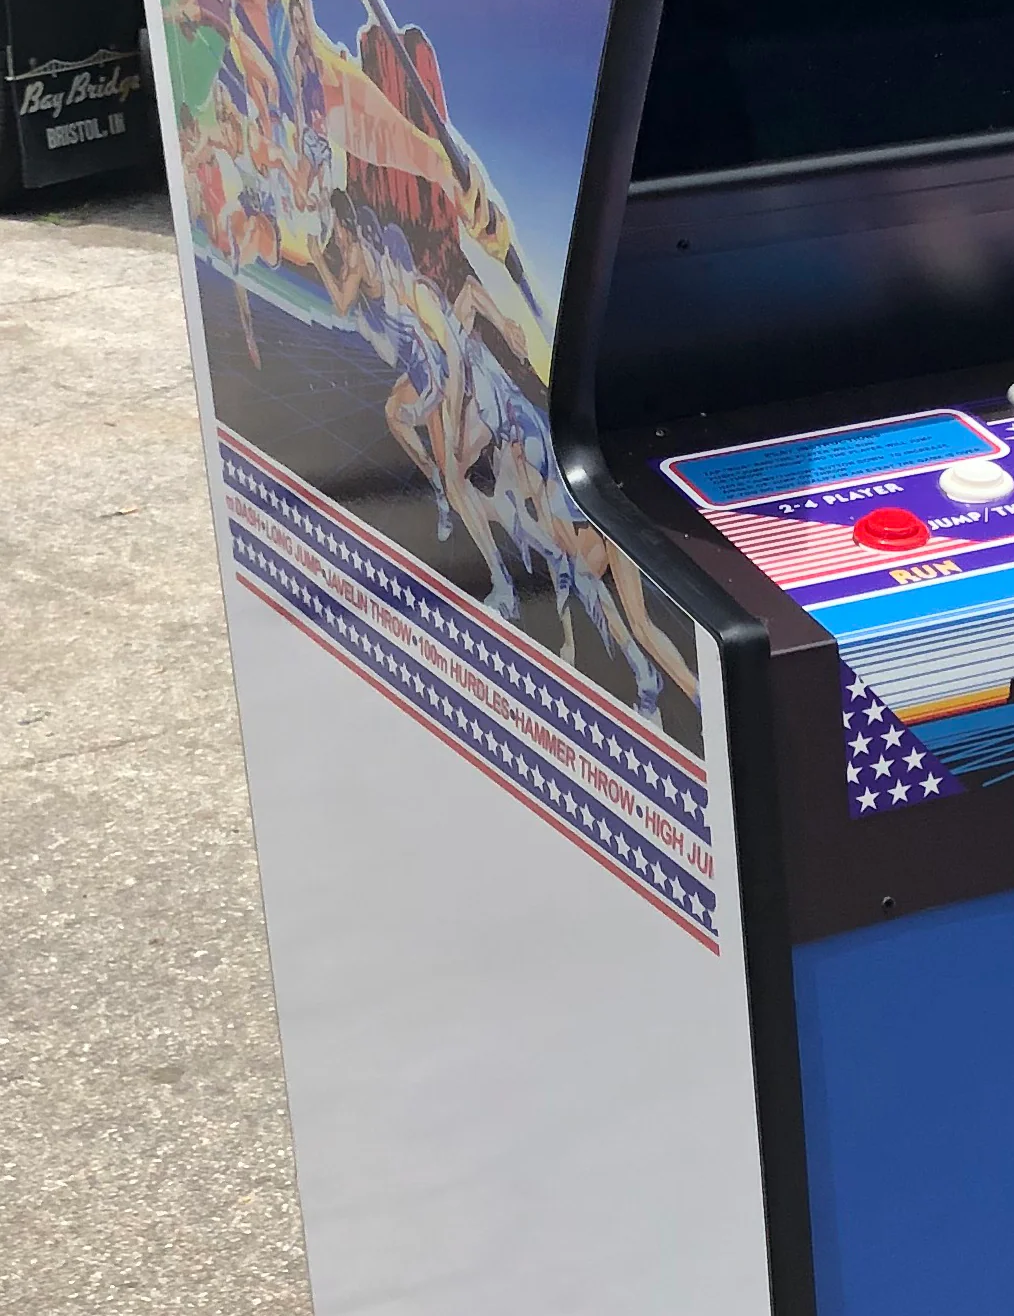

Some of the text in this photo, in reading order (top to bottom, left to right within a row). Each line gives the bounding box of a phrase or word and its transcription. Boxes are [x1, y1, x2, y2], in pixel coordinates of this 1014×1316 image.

[20, 65, 141, 118] Bay Bridge
[779, 483, 904, 514] 2-4 PLAYER
[888, 559, 964, 586] RUN
[235, 496, 260, 531] DASH
[266, 519, 293, 556] LONG
[294, 544, 321, 576] JUMP
[325, 568, 368, 614] JAVELIN
[370, 598, 412, 646] THROW
[418, 636, 448, 674] 100m
[450, 657, 510, 720] HURDLES
[515, 707, 577, 772] HAMMER
[579, 754, 635, 816] THROW
[645, 805, 684, 857] HIGH
